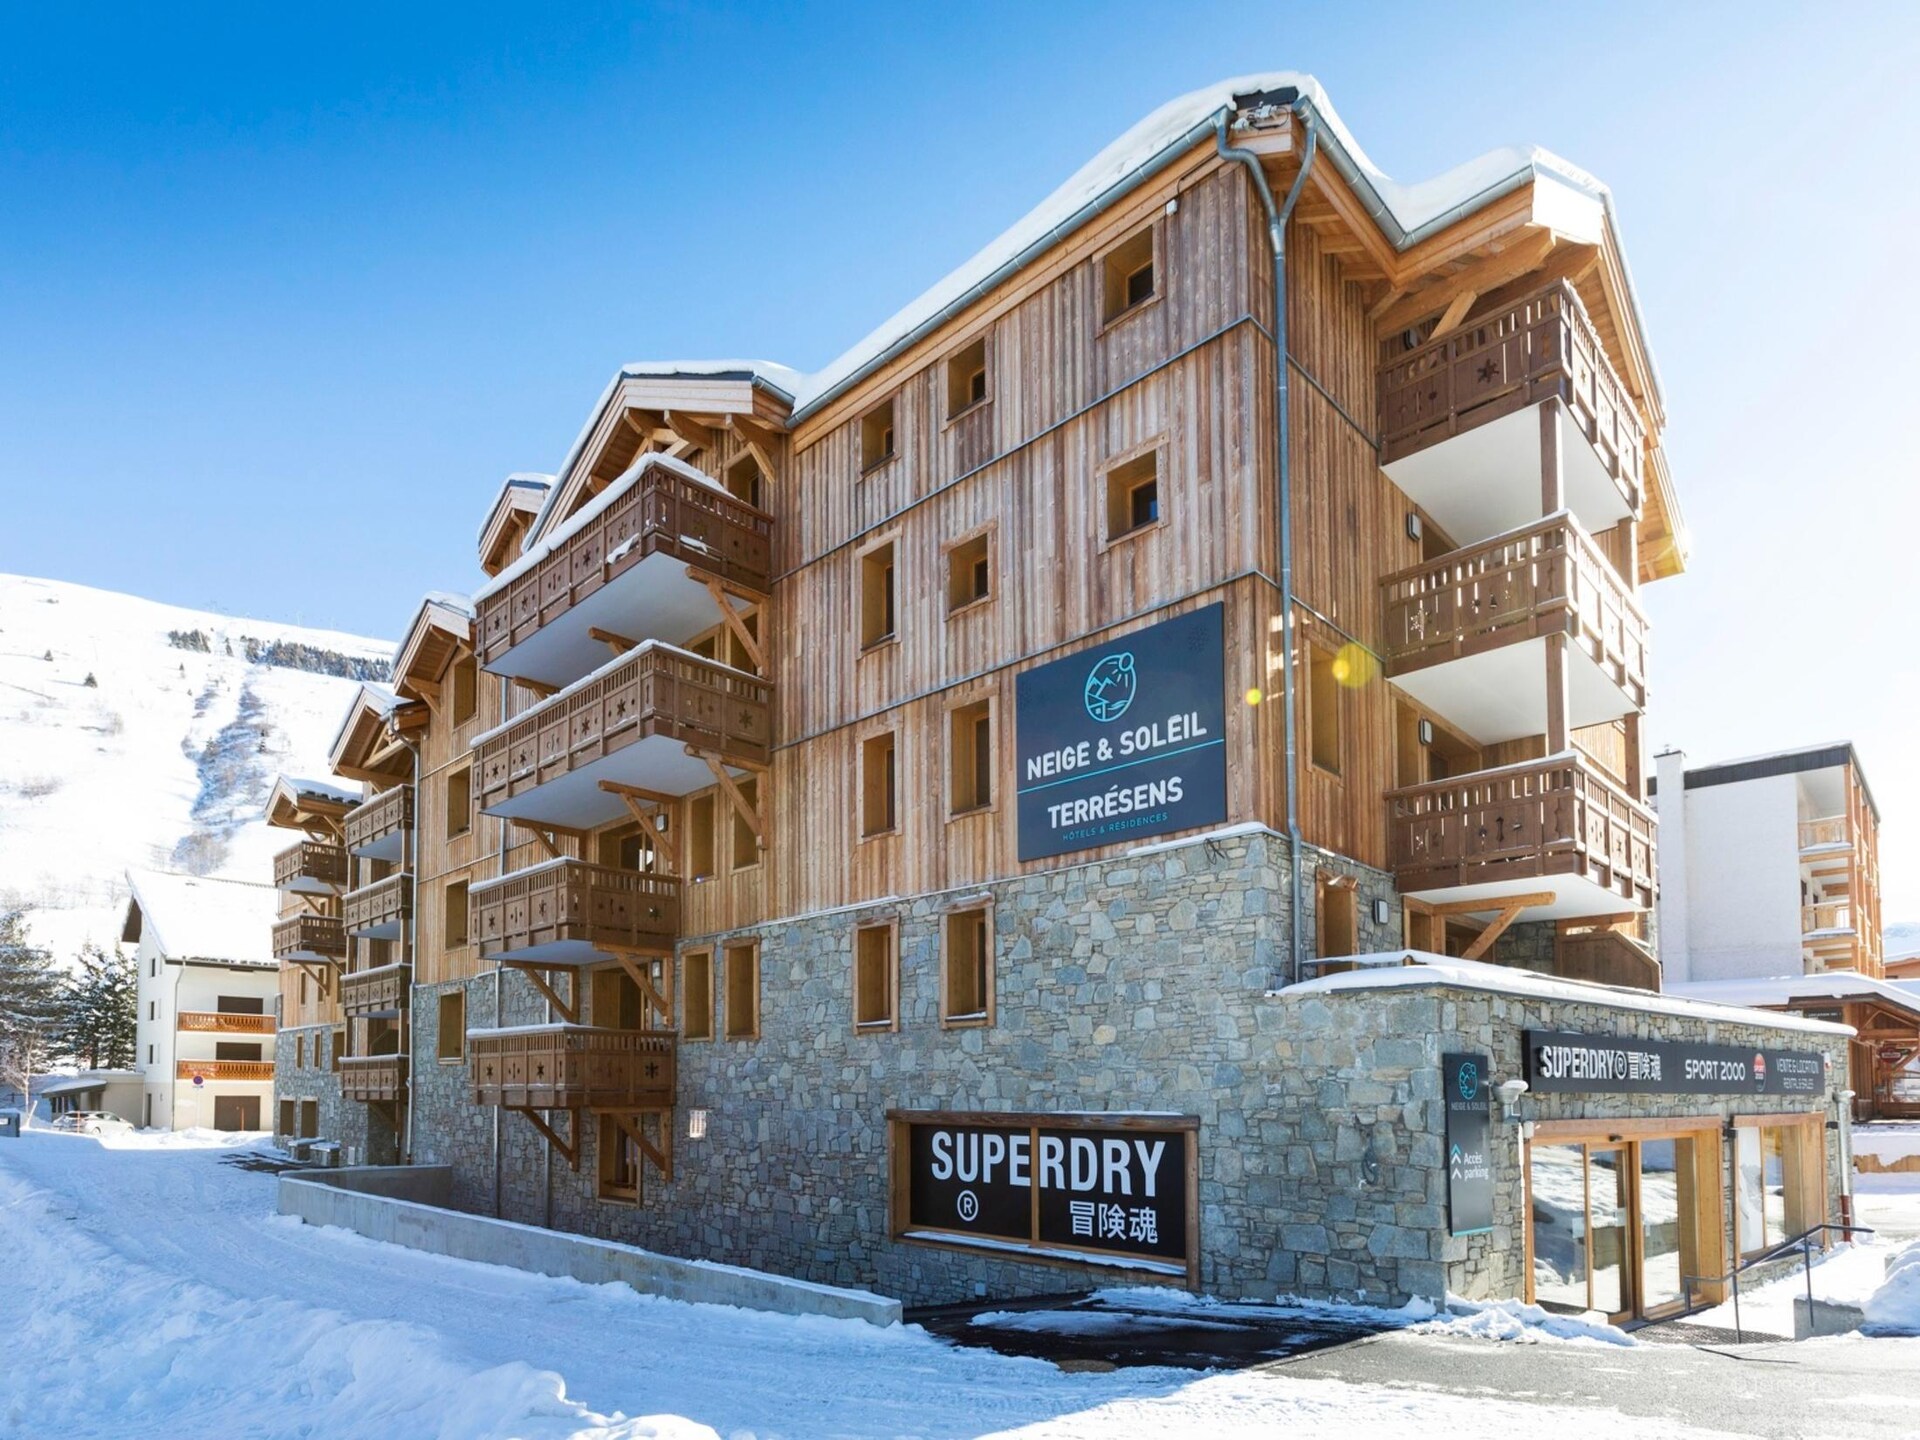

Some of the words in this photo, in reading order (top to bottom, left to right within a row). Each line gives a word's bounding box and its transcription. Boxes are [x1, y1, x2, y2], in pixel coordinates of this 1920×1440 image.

[1026, 740, 1090, 780] NEIGE
[1096, 738, 1113, 761] &
[1119, 711, 1207, 756] SOLEIL
[1047, 776, 1183, 829] TERRÉSENS
[1063, 827, 1096, 841] HÔTELS
[1100, 826, 1105, 834] &
[1109, 812, 1168, 832] RÉSIDENCES
[1685, 1059, 1718, 1081] SPORT
[1720, 1060, 1746, 1081] 2000
[931, 1131, 1166, 1197] SUPERDRY
[1463, 1152, 1482, 1165] Accès
[1464, 1165, 1489, 1181] parking
[1069, 1200, 1159, 1244] 冒険魂
